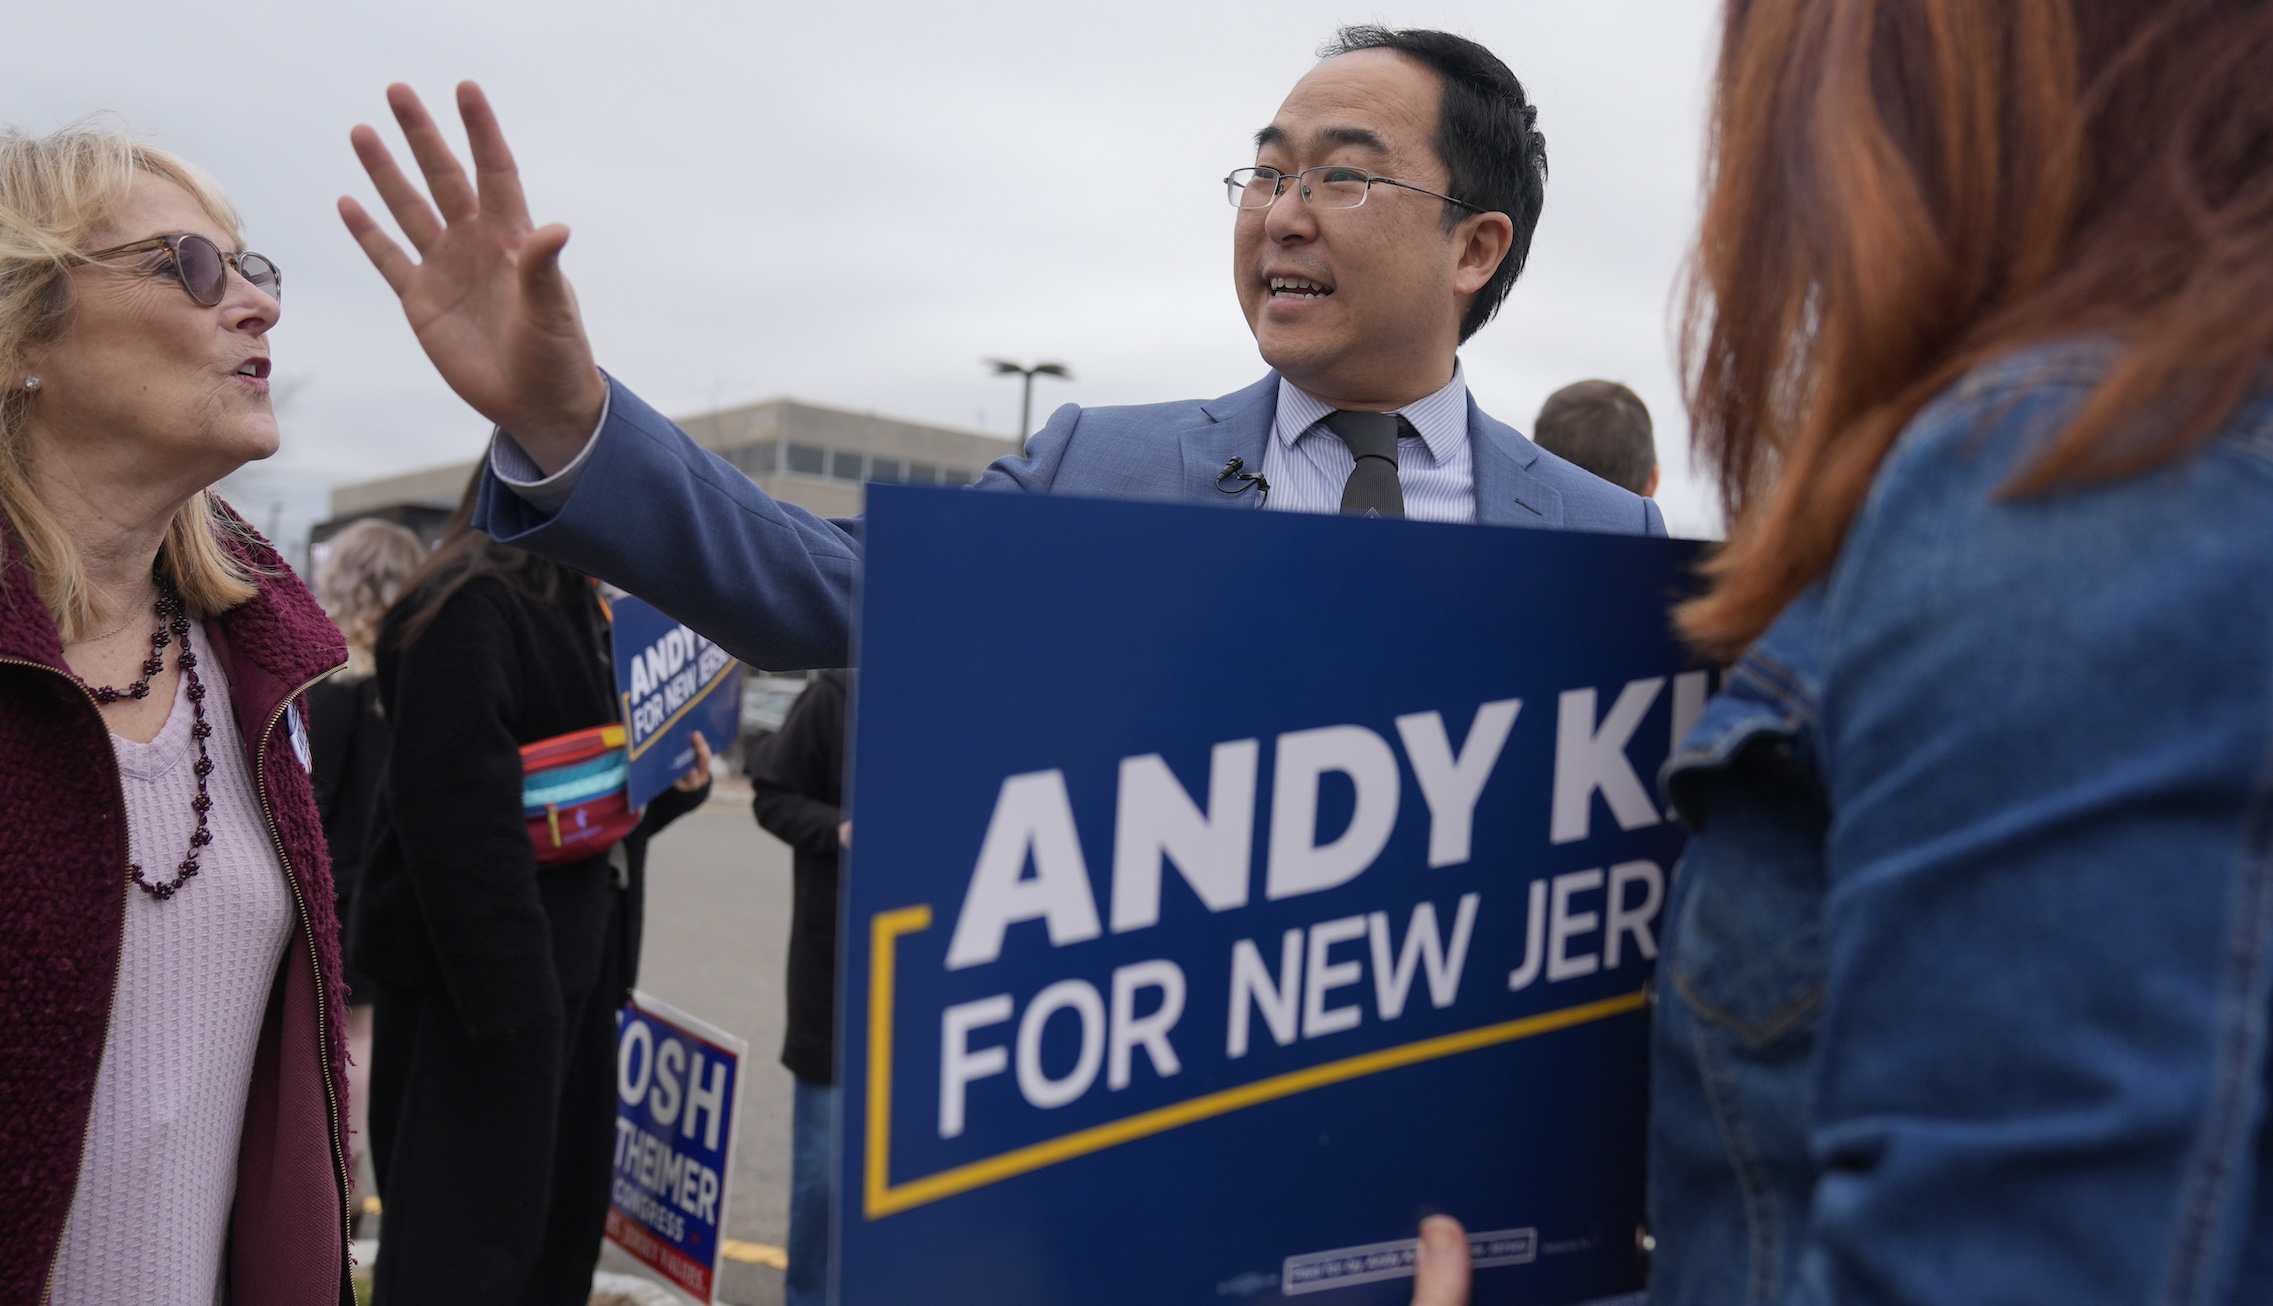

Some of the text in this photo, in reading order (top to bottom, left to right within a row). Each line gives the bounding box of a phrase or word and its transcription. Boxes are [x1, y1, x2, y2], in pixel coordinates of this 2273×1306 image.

[630, 623, 696, 705] ANDY
[632, 640, 730, 743] FOR NEW JERS
[945, 671, 1710, 971] ANDY KI
[938, 859, 1665, 1139] FOR NEW JER
[617, 1016, 727, 1153] OSH
[614, 1116, 718, 1226] THEIMER
